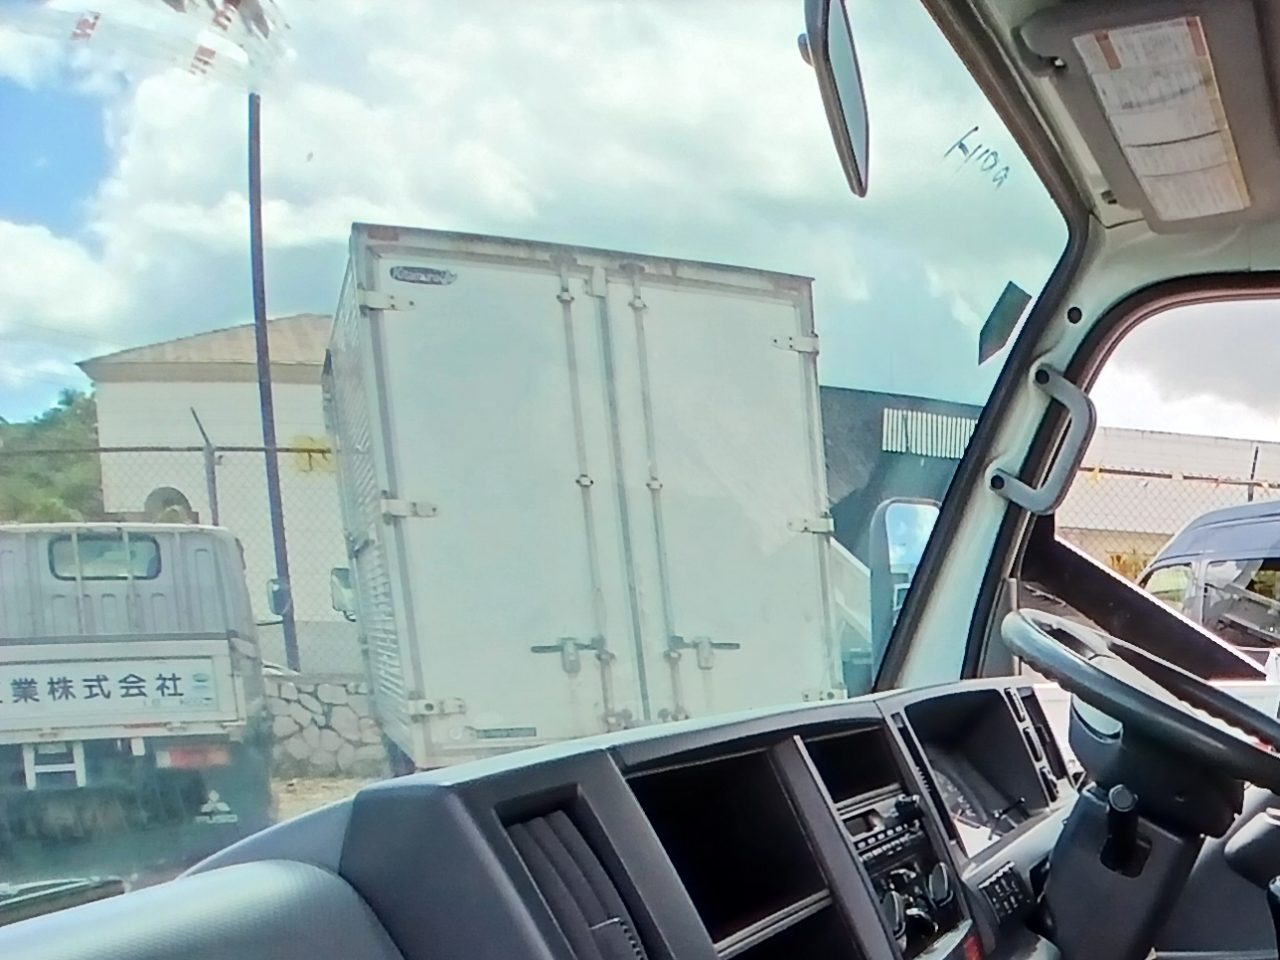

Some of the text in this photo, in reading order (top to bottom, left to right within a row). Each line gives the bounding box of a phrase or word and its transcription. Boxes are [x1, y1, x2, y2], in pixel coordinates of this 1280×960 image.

[0, 672, 185, 704] 業株式会社
